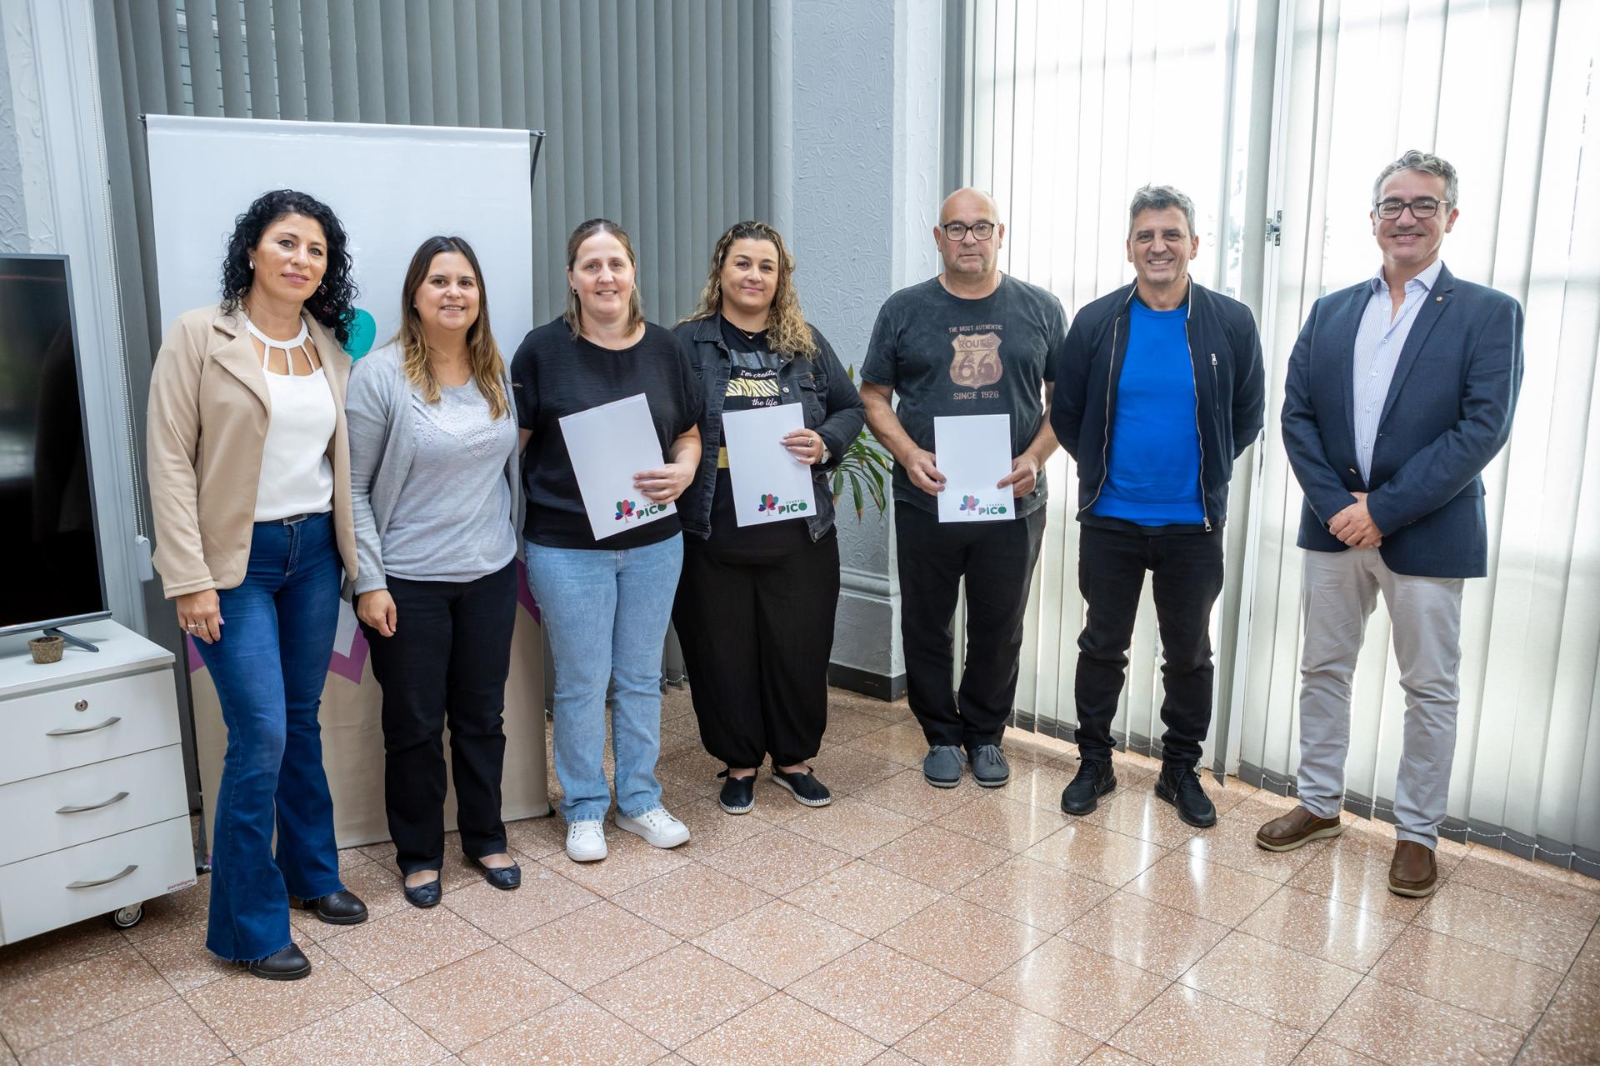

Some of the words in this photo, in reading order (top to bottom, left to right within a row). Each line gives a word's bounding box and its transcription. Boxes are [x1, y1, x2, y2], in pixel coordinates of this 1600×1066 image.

[959, 339, 993, 349] ROUTE
[957, 352, 995, 379] 66
[953, 391, 977, 400] SINCE
[980, 391, 999, 399] 1926
[751, 398, 764, 406] the
[765, 398, 778, 407] life
[636, 504, 667, 519] PICO
[778, 502, 808, 515] PICO
[978, 506, 1007, 516] PICO
